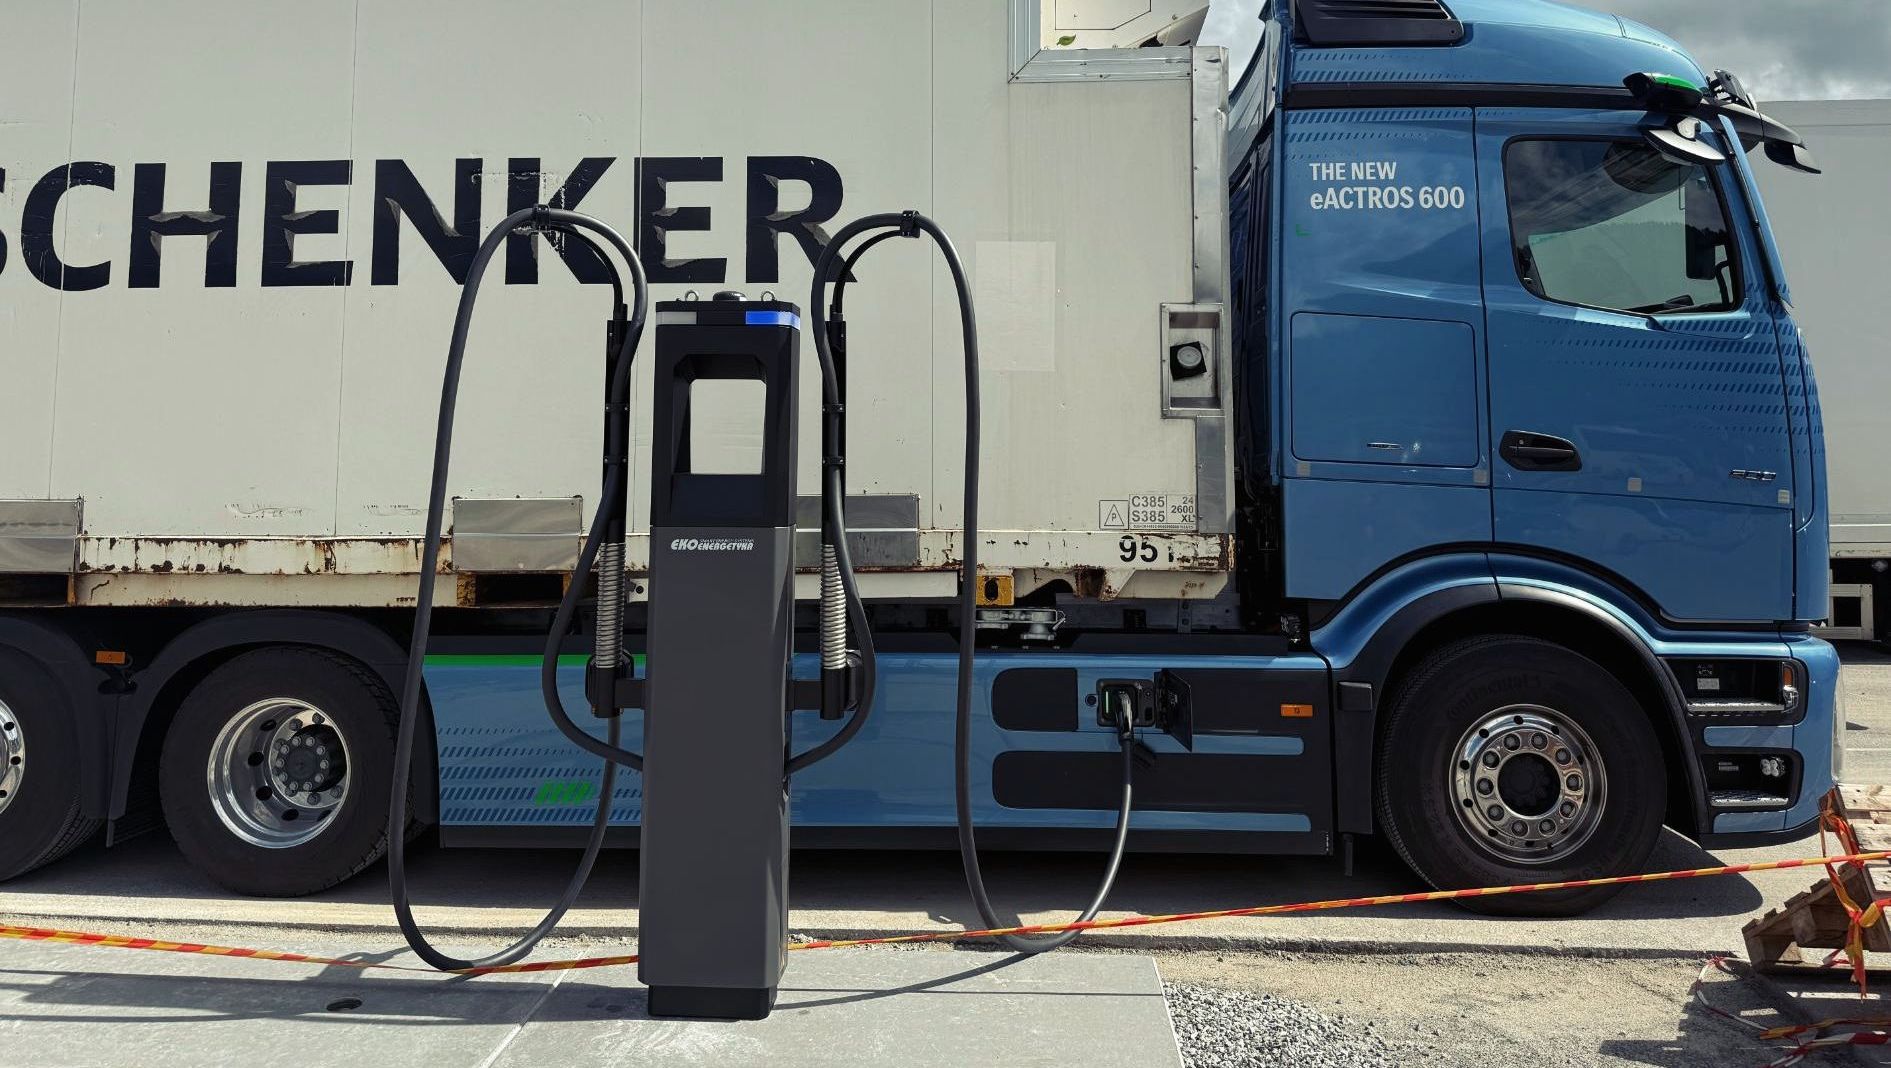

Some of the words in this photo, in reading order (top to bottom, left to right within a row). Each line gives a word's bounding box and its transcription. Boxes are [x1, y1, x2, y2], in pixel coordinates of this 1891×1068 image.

[1309, 162, 1346, 181] THE
[1351, 162, 1397, 180] NEW
[1310, 186, 1415, 210] eACTROS
[1418, 186, 1465, 209] 600
[0, 156, 857, 291] CHENKER
[1131, 495, 1165, 507] C385
[1182, 496, 1194, 505] 24
[1171, 505, 1194, 514] 2600
[1131, 510, 1165, 523] S385
